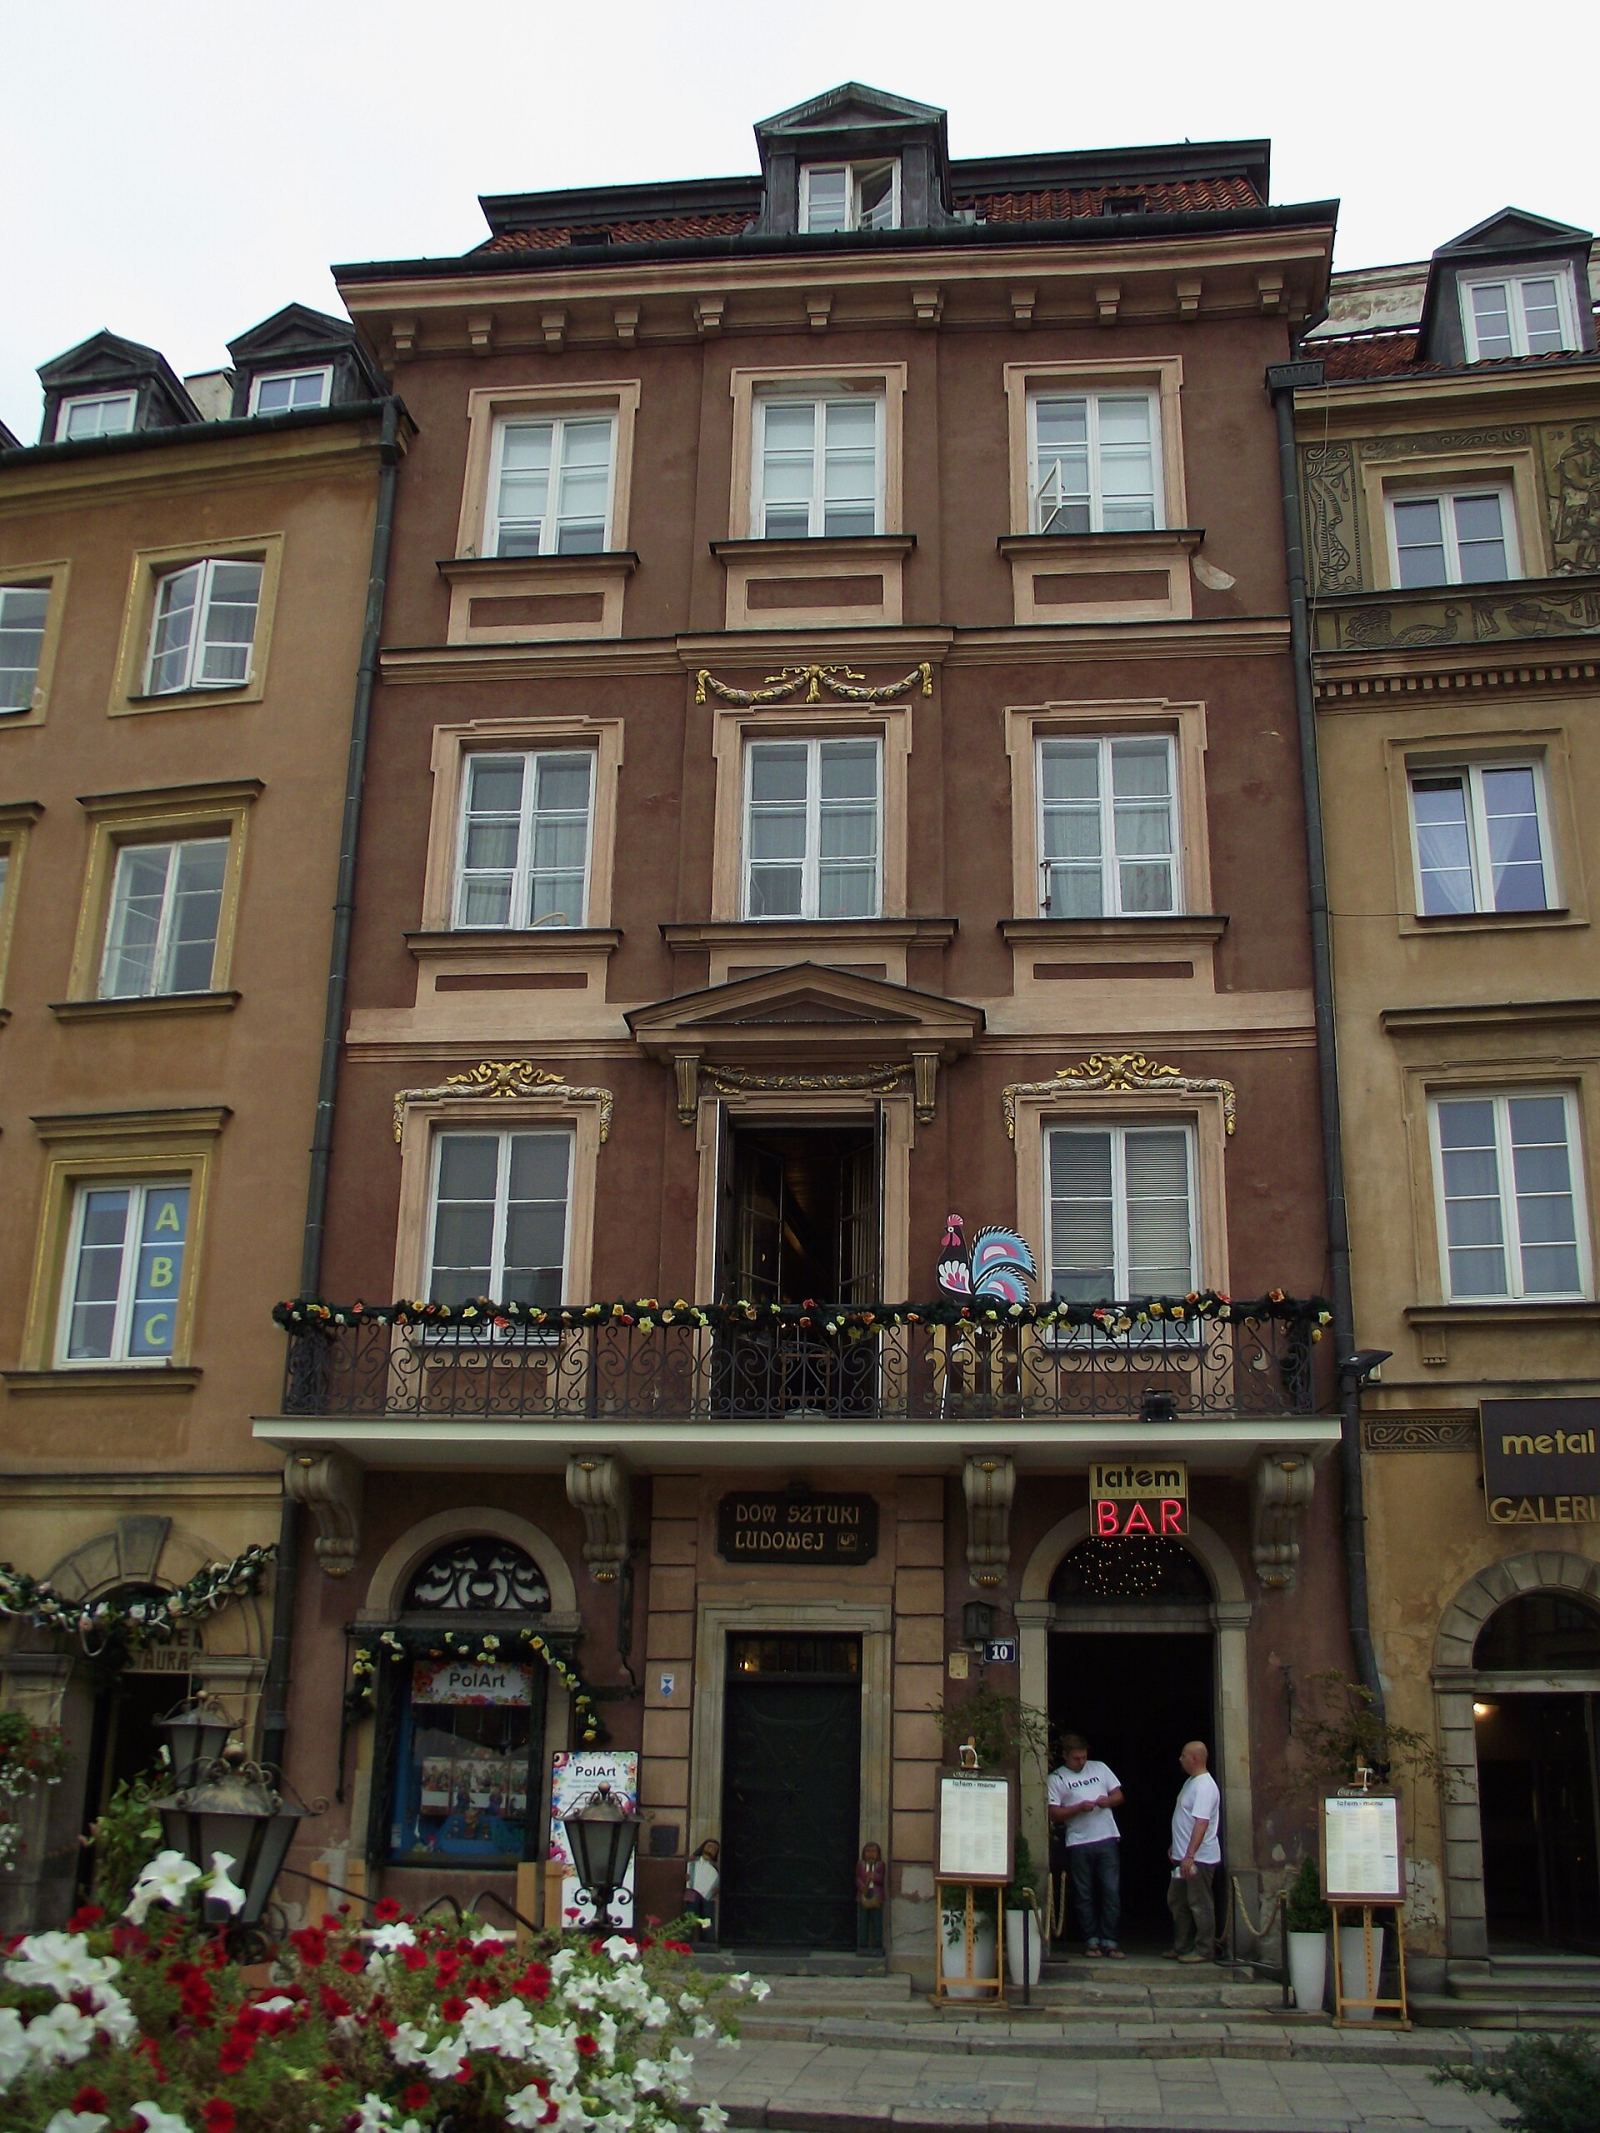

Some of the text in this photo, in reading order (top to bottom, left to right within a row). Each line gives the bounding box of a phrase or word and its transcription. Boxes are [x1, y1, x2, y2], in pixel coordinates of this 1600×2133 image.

[154, 1202, 180, 1231] A
[150, 1256, 173, 1288] B
[144, 1313, 168, 1345] C
[1502, 1429, 1596, 1455] metal
[1096, 1466, 1180, 1488] latem
[736, 1504, 860, 1525] DOM SZTUKI
[1097, 1499, 1184, 1537] BAR
[735, 1531, 824, 1550] LUDOWEJ
[991, 1645, 1008, 1660] 10
[449, 1672, 506, 1689] PolArt
[575, 1766, 616, 1777] PolArt
[1067, 1776, 1100, 1790] latem
